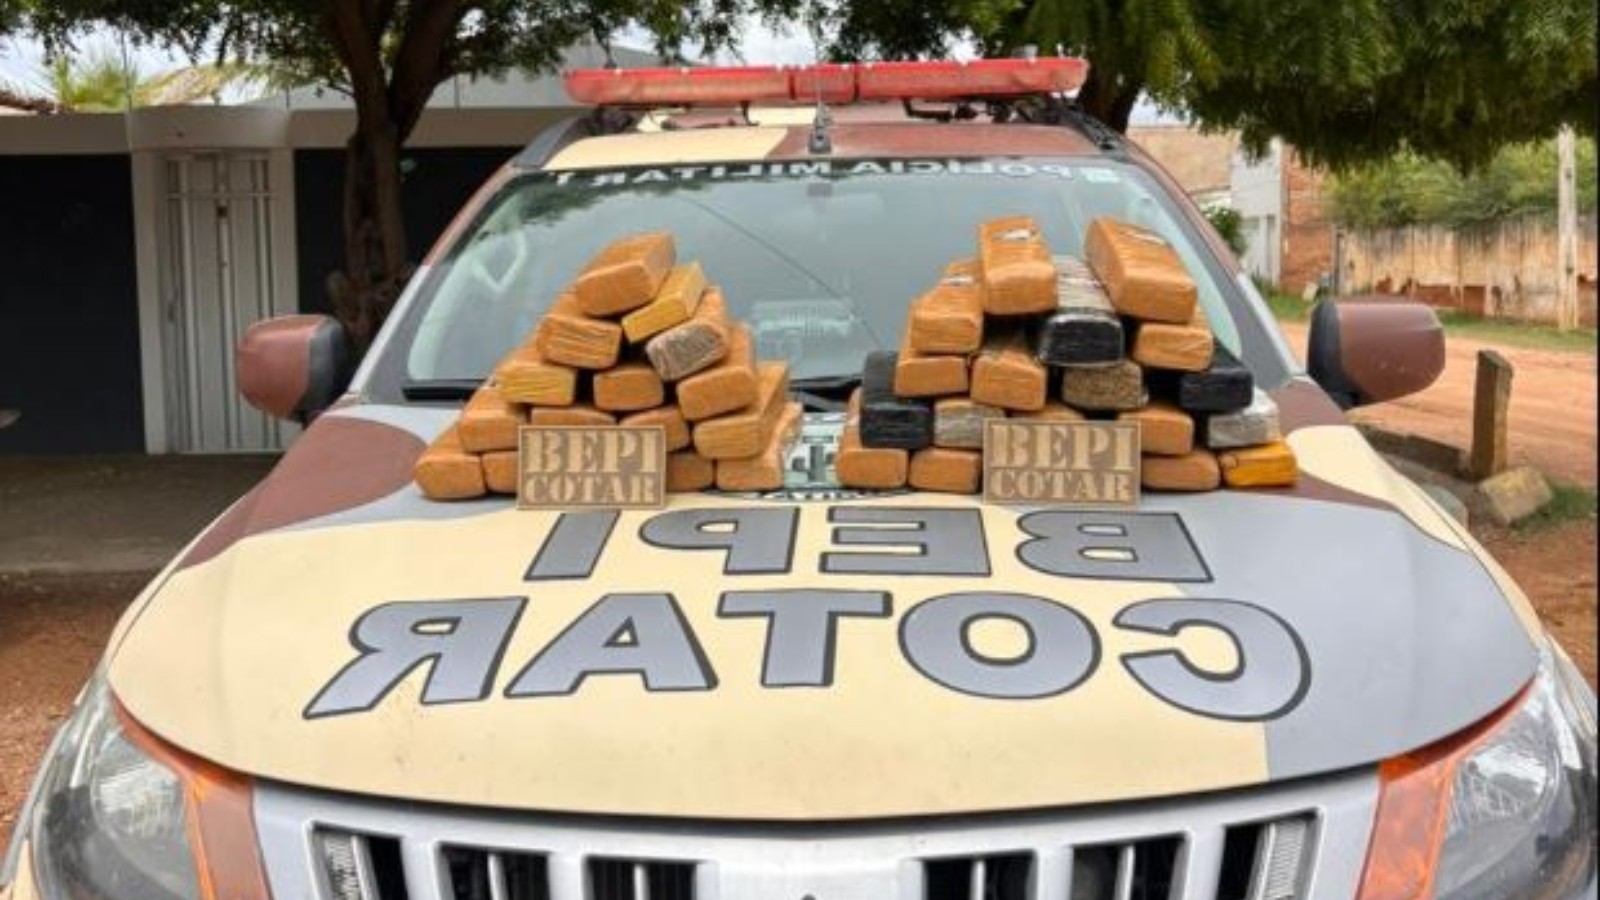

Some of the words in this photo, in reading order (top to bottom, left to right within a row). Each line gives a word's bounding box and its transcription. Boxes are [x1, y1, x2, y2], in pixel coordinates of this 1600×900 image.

[524, 429, 658, 473] BEPI
[989, 424, 1137, 470] BEPI
[524, 474, 656, 504] COTAR
[989, 469, 1132, 501] COTAR
